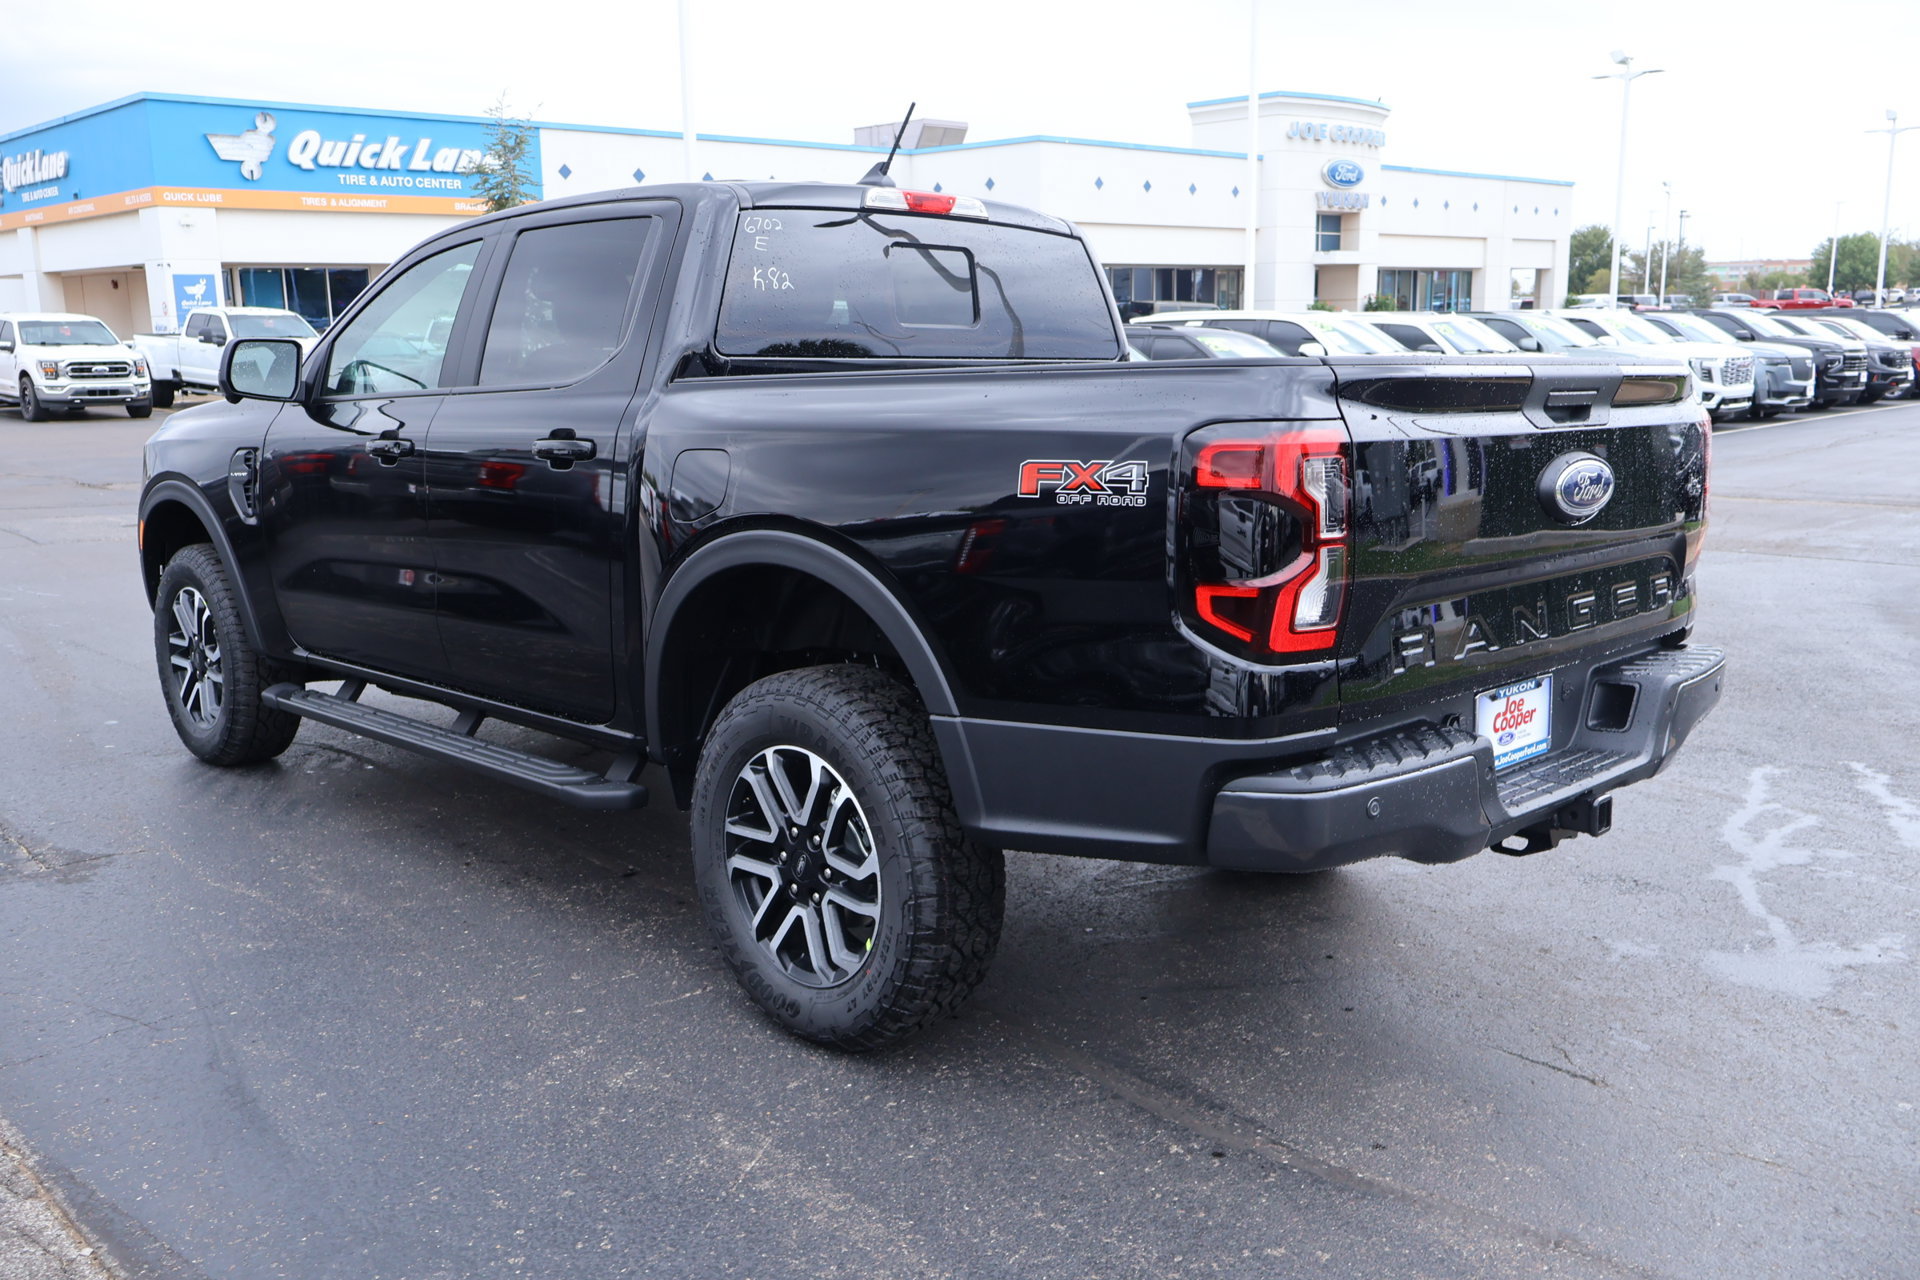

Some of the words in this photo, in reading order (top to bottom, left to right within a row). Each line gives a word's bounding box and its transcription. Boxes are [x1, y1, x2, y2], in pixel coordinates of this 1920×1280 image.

[1287, 121, 1329, 141] JOE
[287, 130, 410, 170] Quick
[2, 151, 35, 193] Quick
[34, 148, 69, 182] Lane
[1334, 163, 1359, 182] Ford
[338, 174, 367, 186] TIRE
[368, 175, 378, 187] &
[380, 176, 414, 188] AUTO
[415, 177, 462, 190] CENTER
[163, 192, 195, 201] QUICK
[197, 193, 223, 203] LUBE
[301, 196, 328, 207] TIRES
[330, 198, 337, 208] &
[337, 198, 388, 209] ALIGNMENT
[1317, 192, 1370, 209] YUKON
[744, 217, 783, 233] 6702
[755, 236, 769, 251] E
[1017, 460, 1149, 498] FX4
[1573, 472, 1605, 501] Ford
[1056, 494, 1092, 505] OFF
[1097, 495, 1147, 507] ROAD
[1390, 571, 1674, 675] RANGER
[1498, 680, 1536, 698] YUKON
[1501, 696, 1525, 718] Joe
[1493, 708, 1537, 734] Cooper
[704, 886, 800, 1018] GOODYEAR
